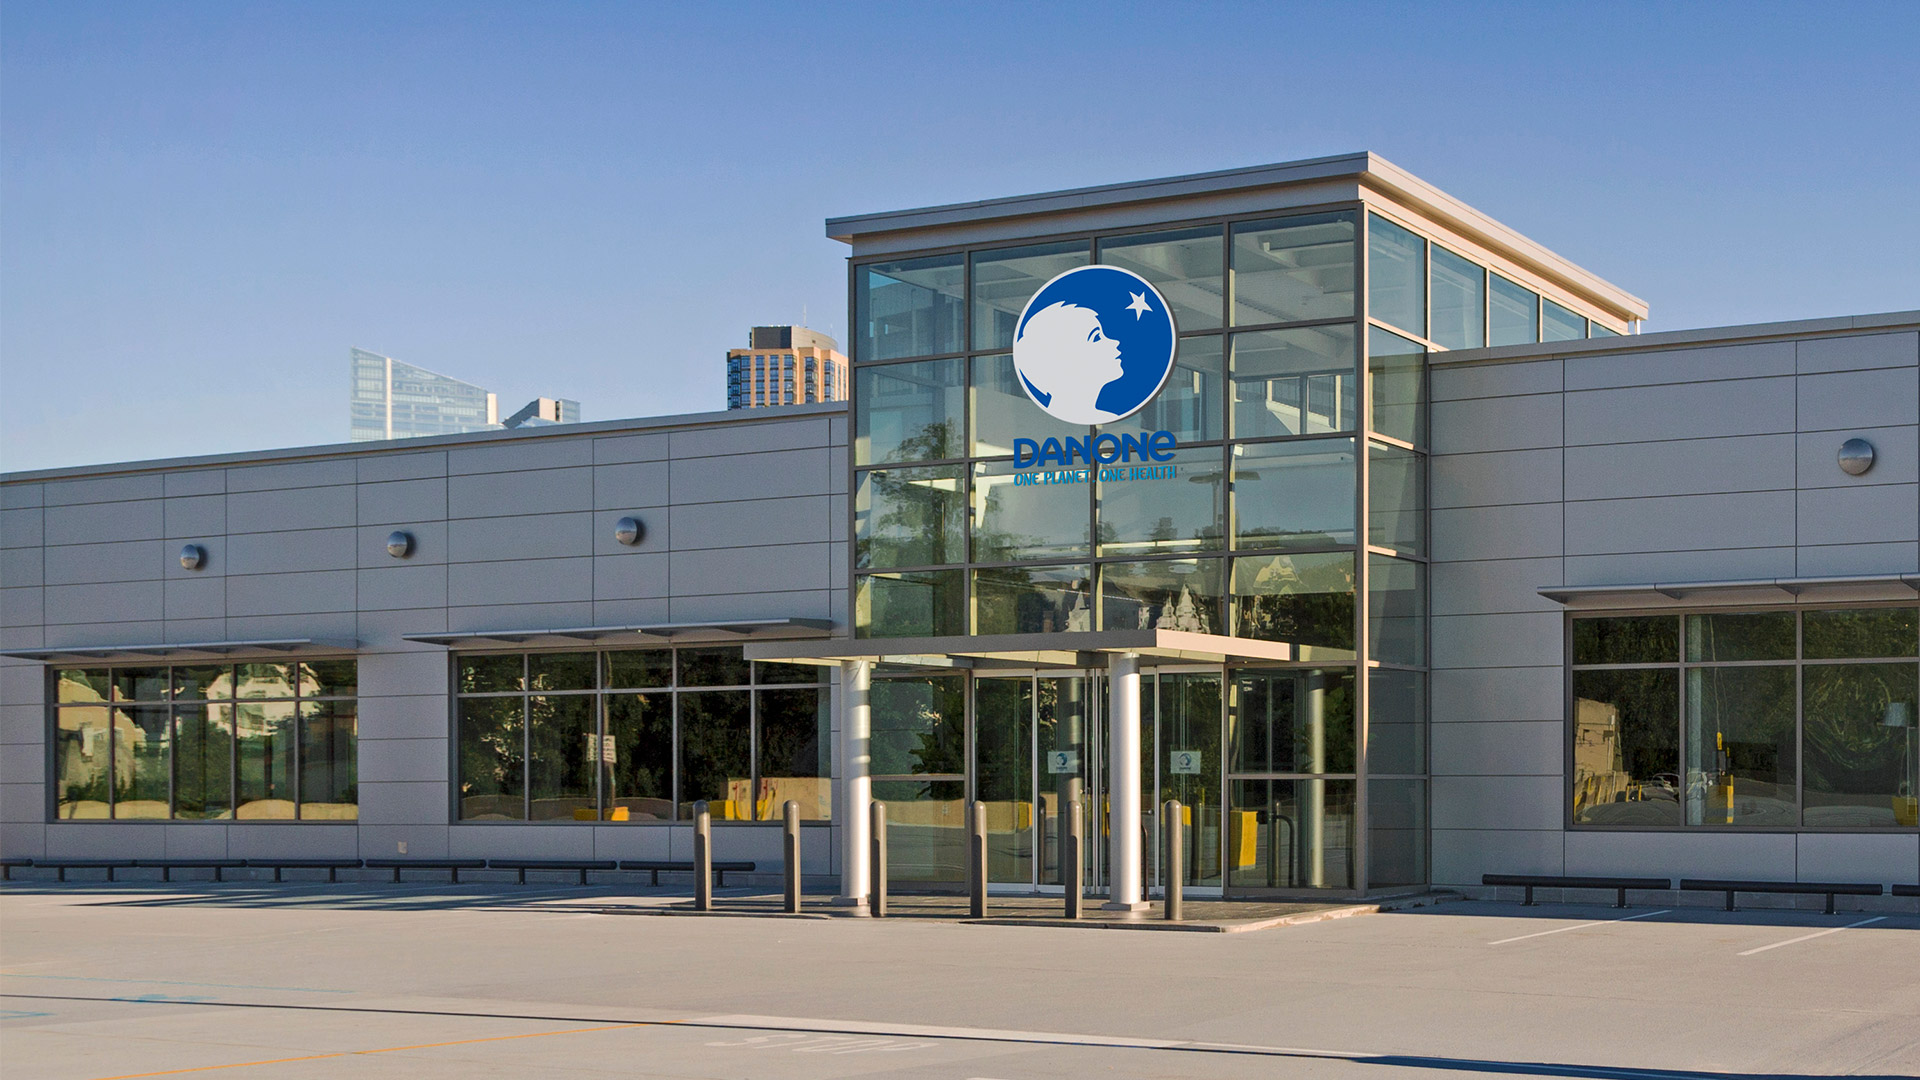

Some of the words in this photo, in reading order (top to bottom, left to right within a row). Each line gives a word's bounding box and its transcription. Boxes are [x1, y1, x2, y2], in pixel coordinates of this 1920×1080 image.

[1013, 430, 1177, 469] DANONE
[1013, 472, 1040, 487] ONE
[1099, 467, 1127, 482] ONE
[1129, 465, 1177, 480] HEALTH
[704, 1033, 941, 1055] STOP
